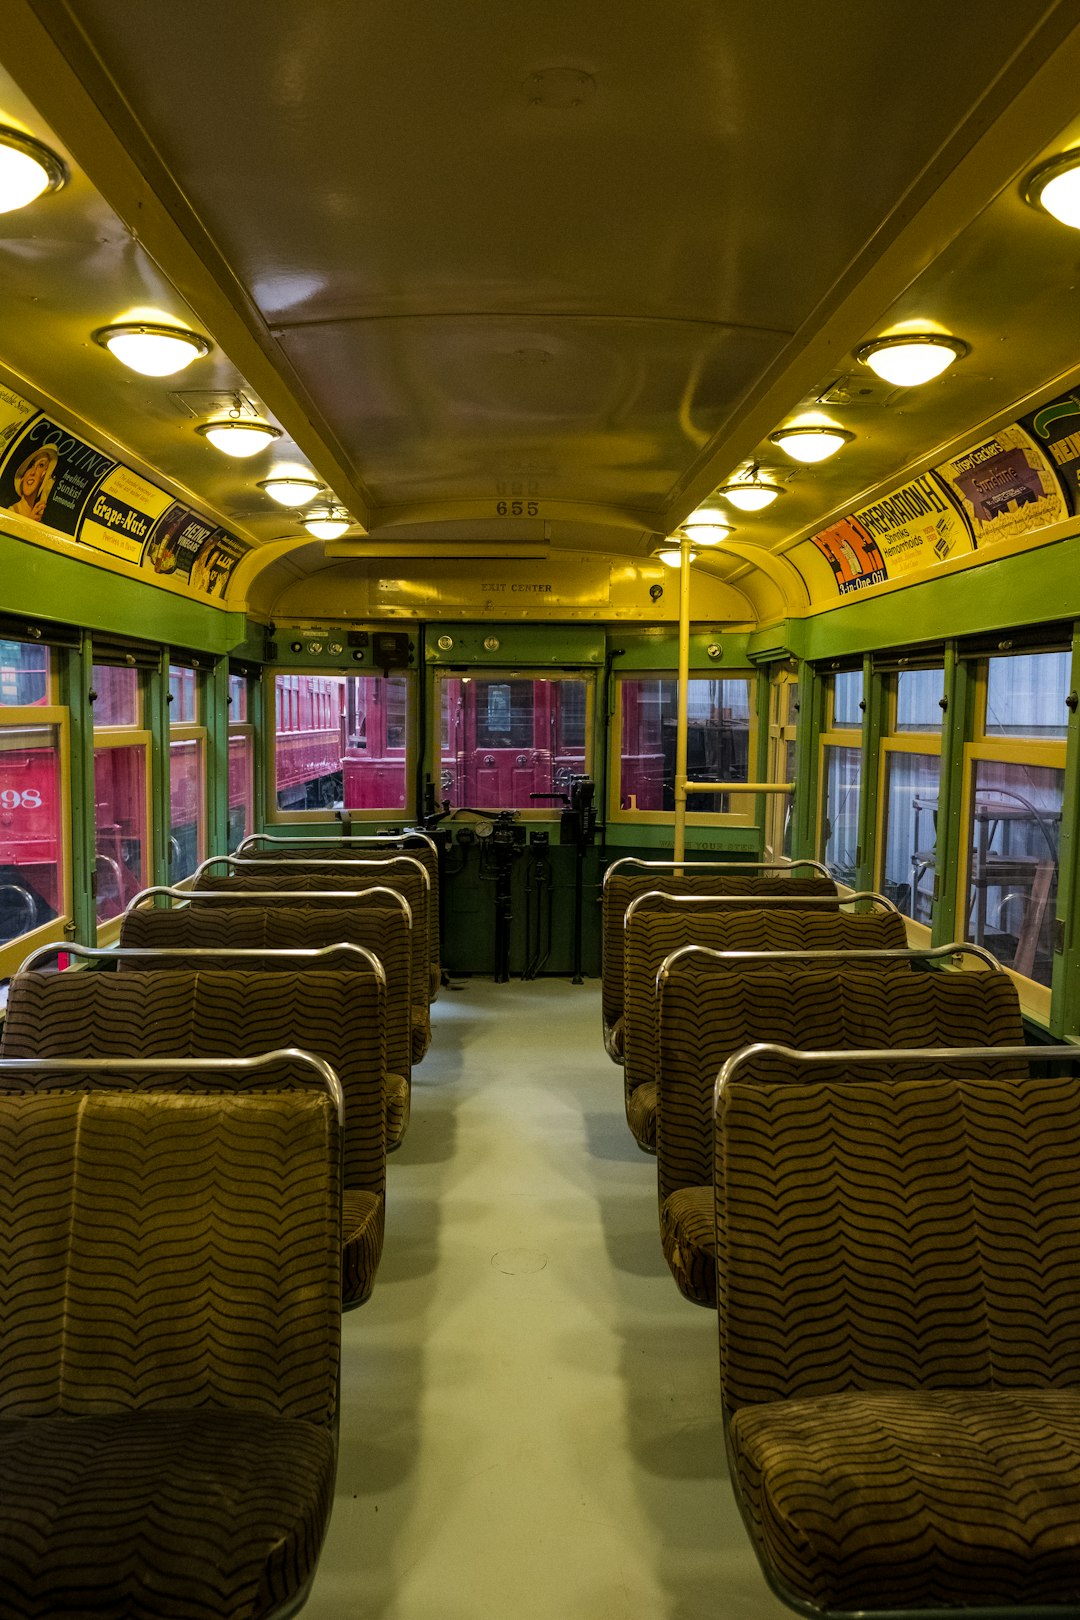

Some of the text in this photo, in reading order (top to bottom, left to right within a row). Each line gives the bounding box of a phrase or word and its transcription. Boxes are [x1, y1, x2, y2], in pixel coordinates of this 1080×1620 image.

[30, 422, 111, 478] COOLING
[951, 442, 1004, 474] Krispy Crackers
[63, 469, 88, 489] healthful
[971, 467, 1018, 494] Sunshine
[52, 490, 75, 509] Lemonade
[57, 480, 82, 500] Sunkist
[496, 501, 539, 516] 655
[857, 484, 933, 538] PREPARATION
[915, 475, 949, 514] H
[181, 522, 211, 545] HEINZ
[884, 528, 910, 545] Shrinks
[882, 535, 924, 558] Hemorrhoids
[216, 554, 235, 570] LUX
[481, 584, 552, 592] EXIT CENTER
[839, 570, 885, 595] 3-in-One Oil
[1, 789, 42, 809] 98
[694, 841, 723, 850] YOUR
